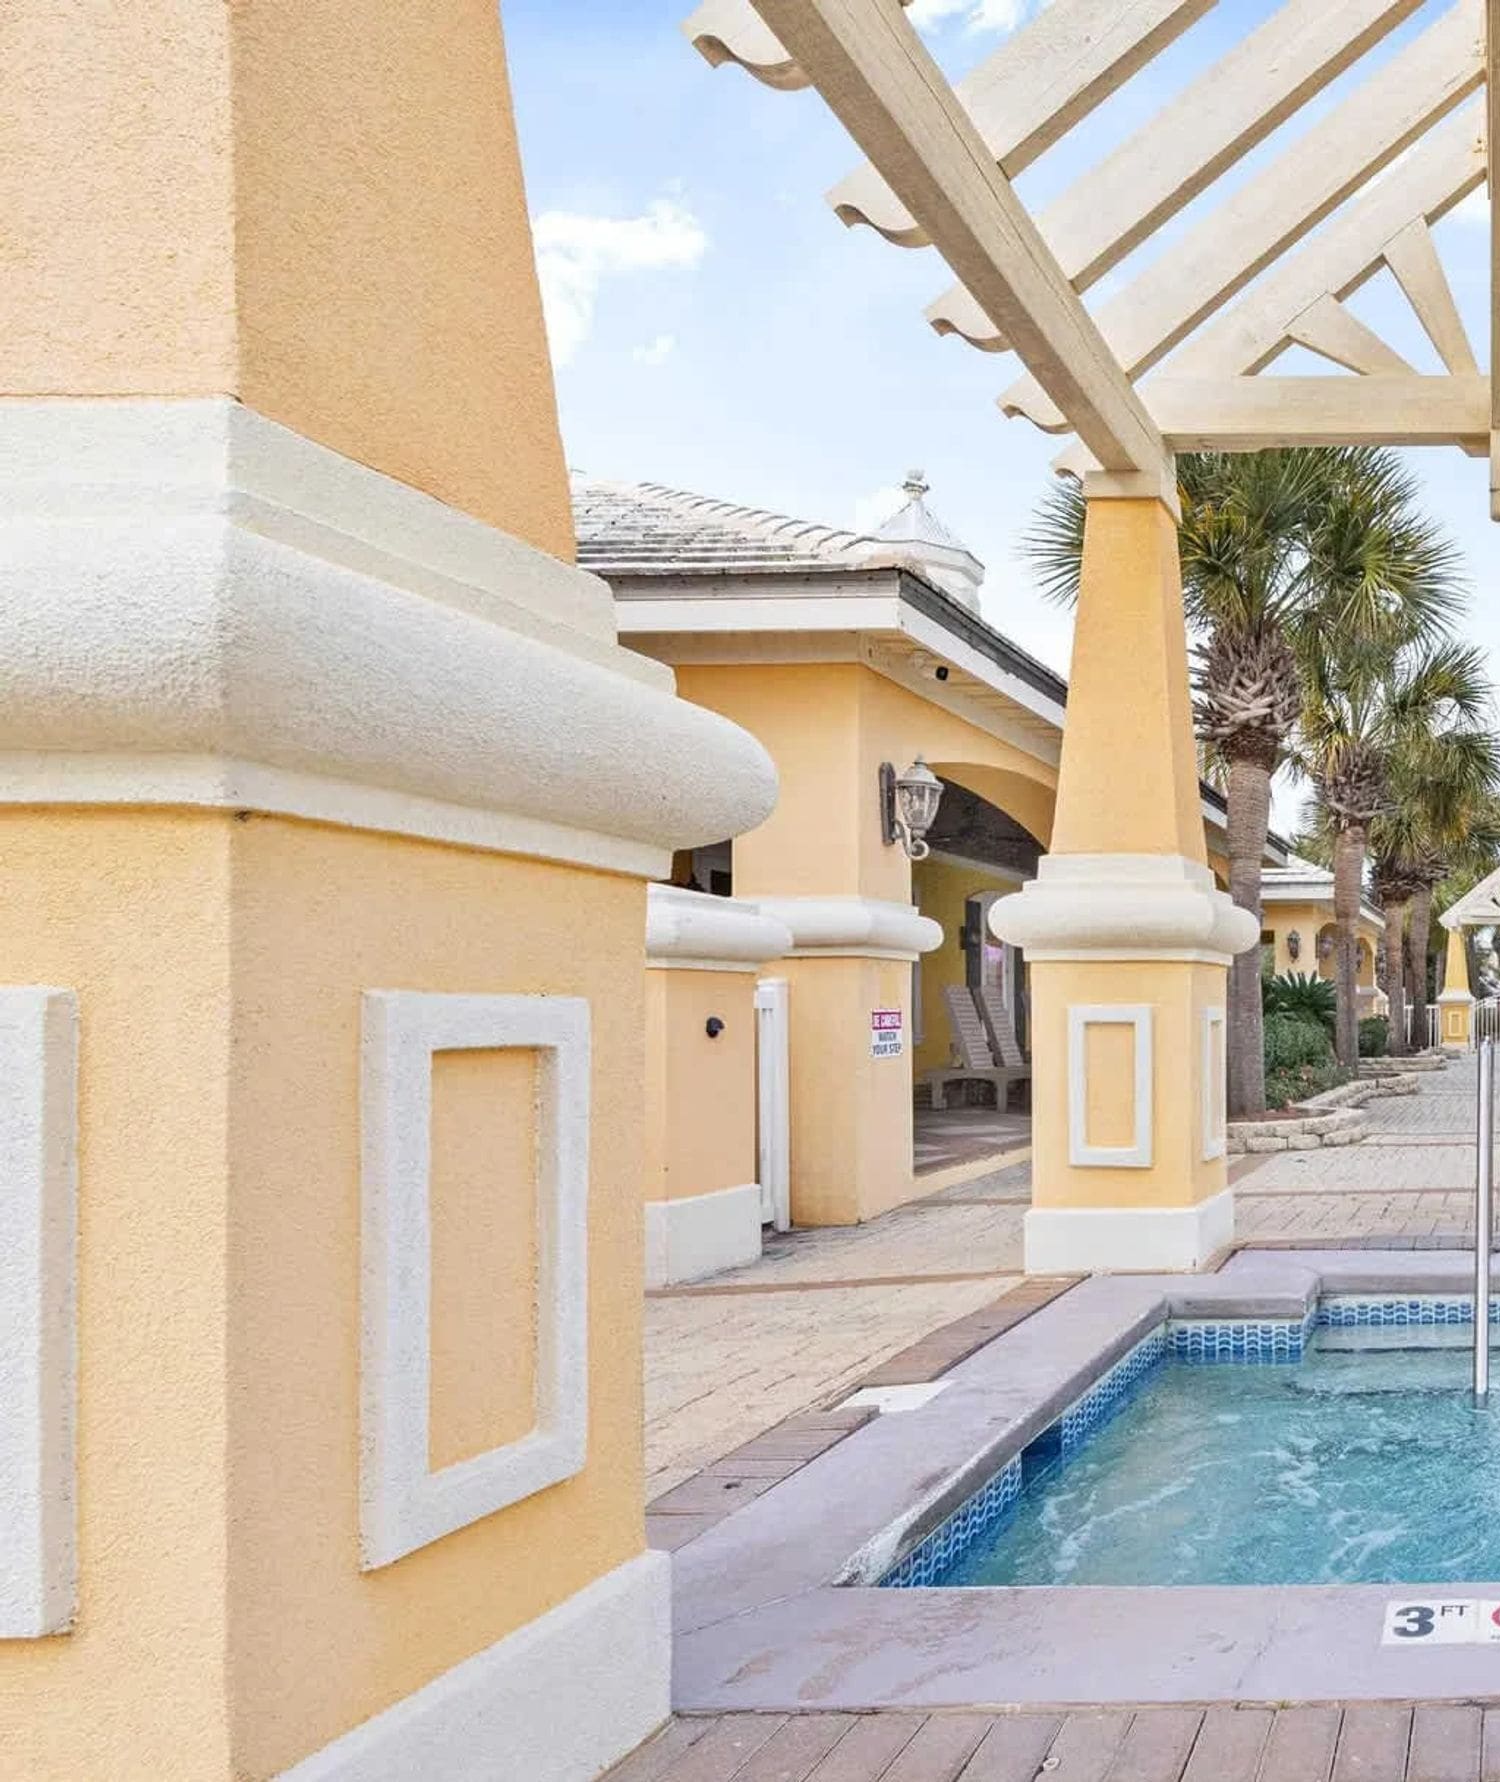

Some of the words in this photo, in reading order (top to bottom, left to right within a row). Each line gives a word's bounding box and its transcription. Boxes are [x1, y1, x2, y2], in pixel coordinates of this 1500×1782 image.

[873, 1043, 888, 1055] YOUR
[889, 1043, 902, 1054] STEP
[1394, 1606, 1435, 1637] 3
[1441, 1605, 1470, 1616] FT
